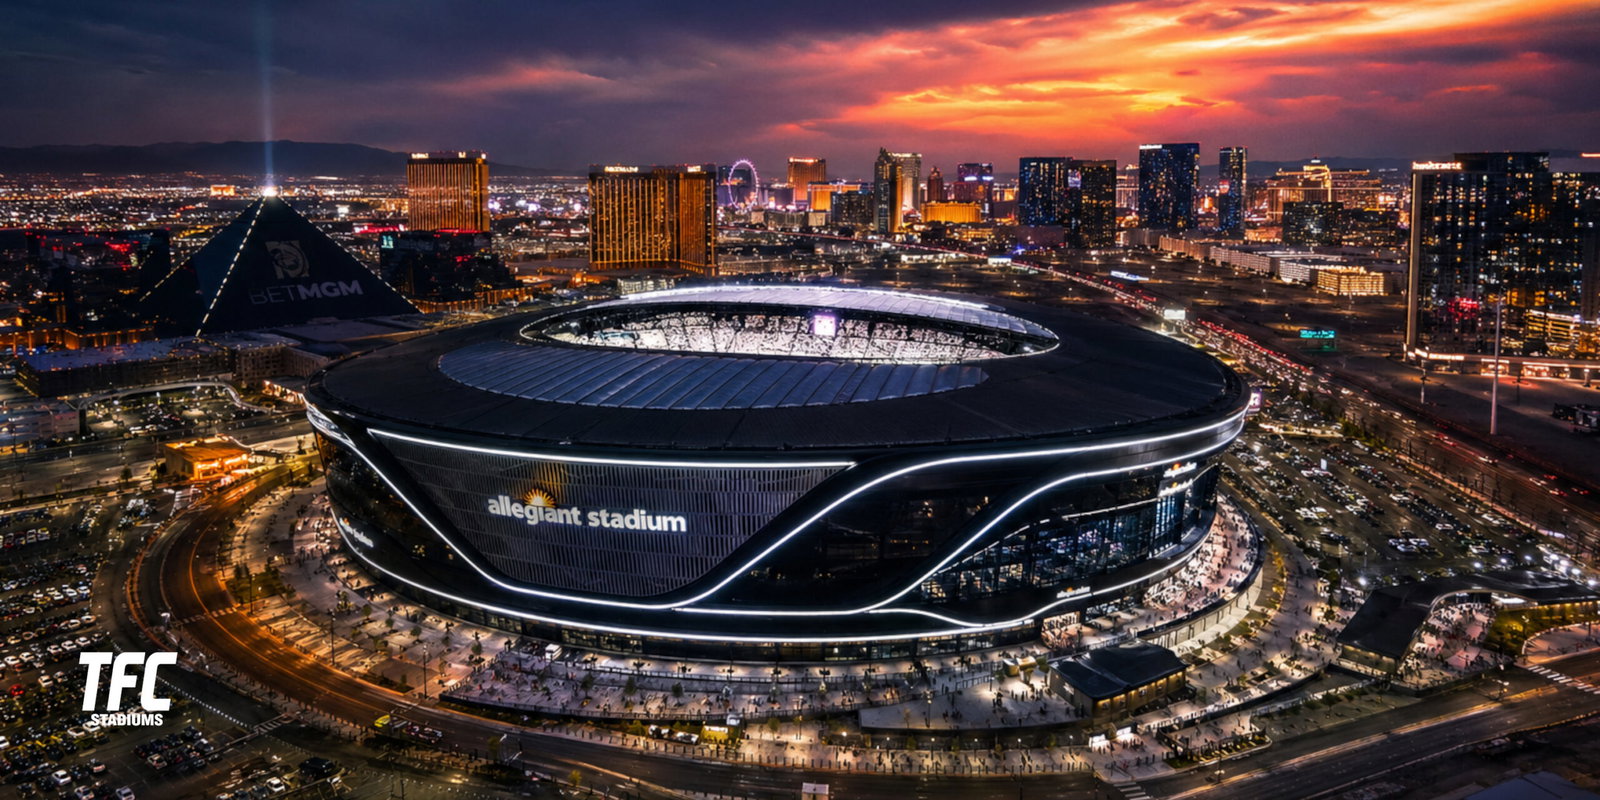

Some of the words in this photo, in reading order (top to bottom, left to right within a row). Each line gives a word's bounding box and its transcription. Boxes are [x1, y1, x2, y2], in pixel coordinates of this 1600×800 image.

[249, 281, 363, 304] BETMGM
[488, 495, 582, 525] allegiant
[588, 509, 687, 532] stadium
